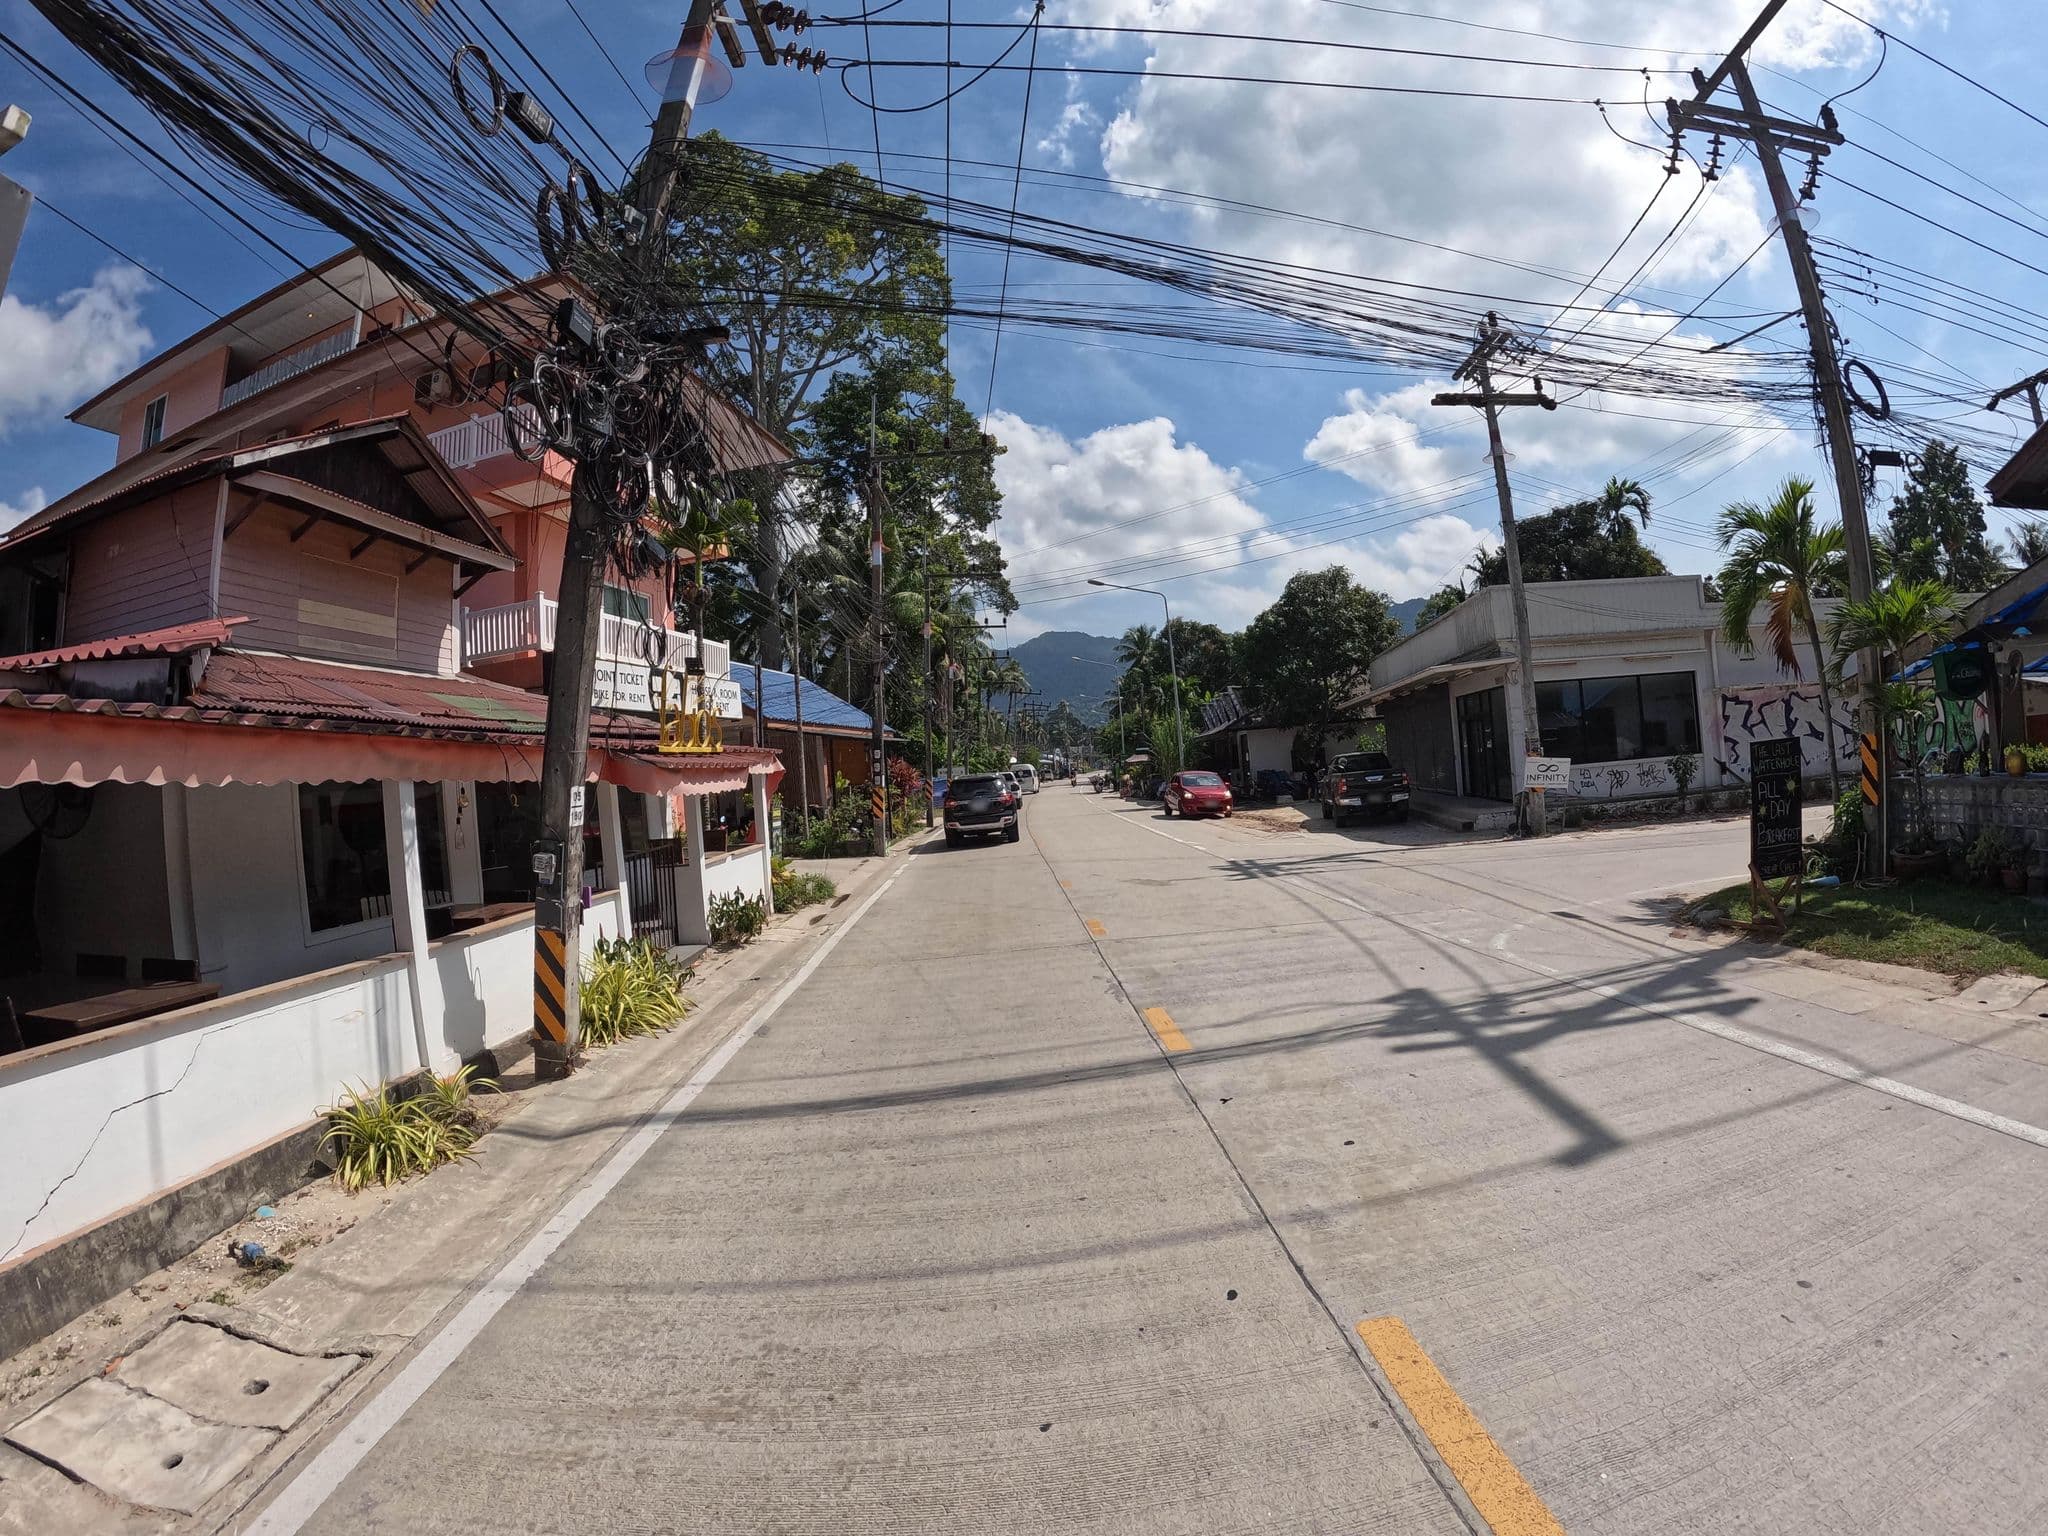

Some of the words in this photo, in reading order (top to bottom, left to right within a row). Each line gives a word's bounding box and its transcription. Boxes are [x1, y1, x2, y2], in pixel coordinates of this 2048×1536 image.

[619, 672, 644, 686] TICKET
[594, 688, 609, 700] BIKE
[629, 692, 646, 704] RENT
[720, 688, 738, 700] ROOM
[1752, 744, 1768, 758] THE
[1771, 741, 1793, 757] LAST
[1752, 755, 1800, 775] WATERHOLE
[1526, 773, 1568, 782] INFINITY
[1758, 781, 1781, 800] ALL
[1770, 799, 1792, 819] DAY
[1757, 822, 1801, 845] BREAKFAST
